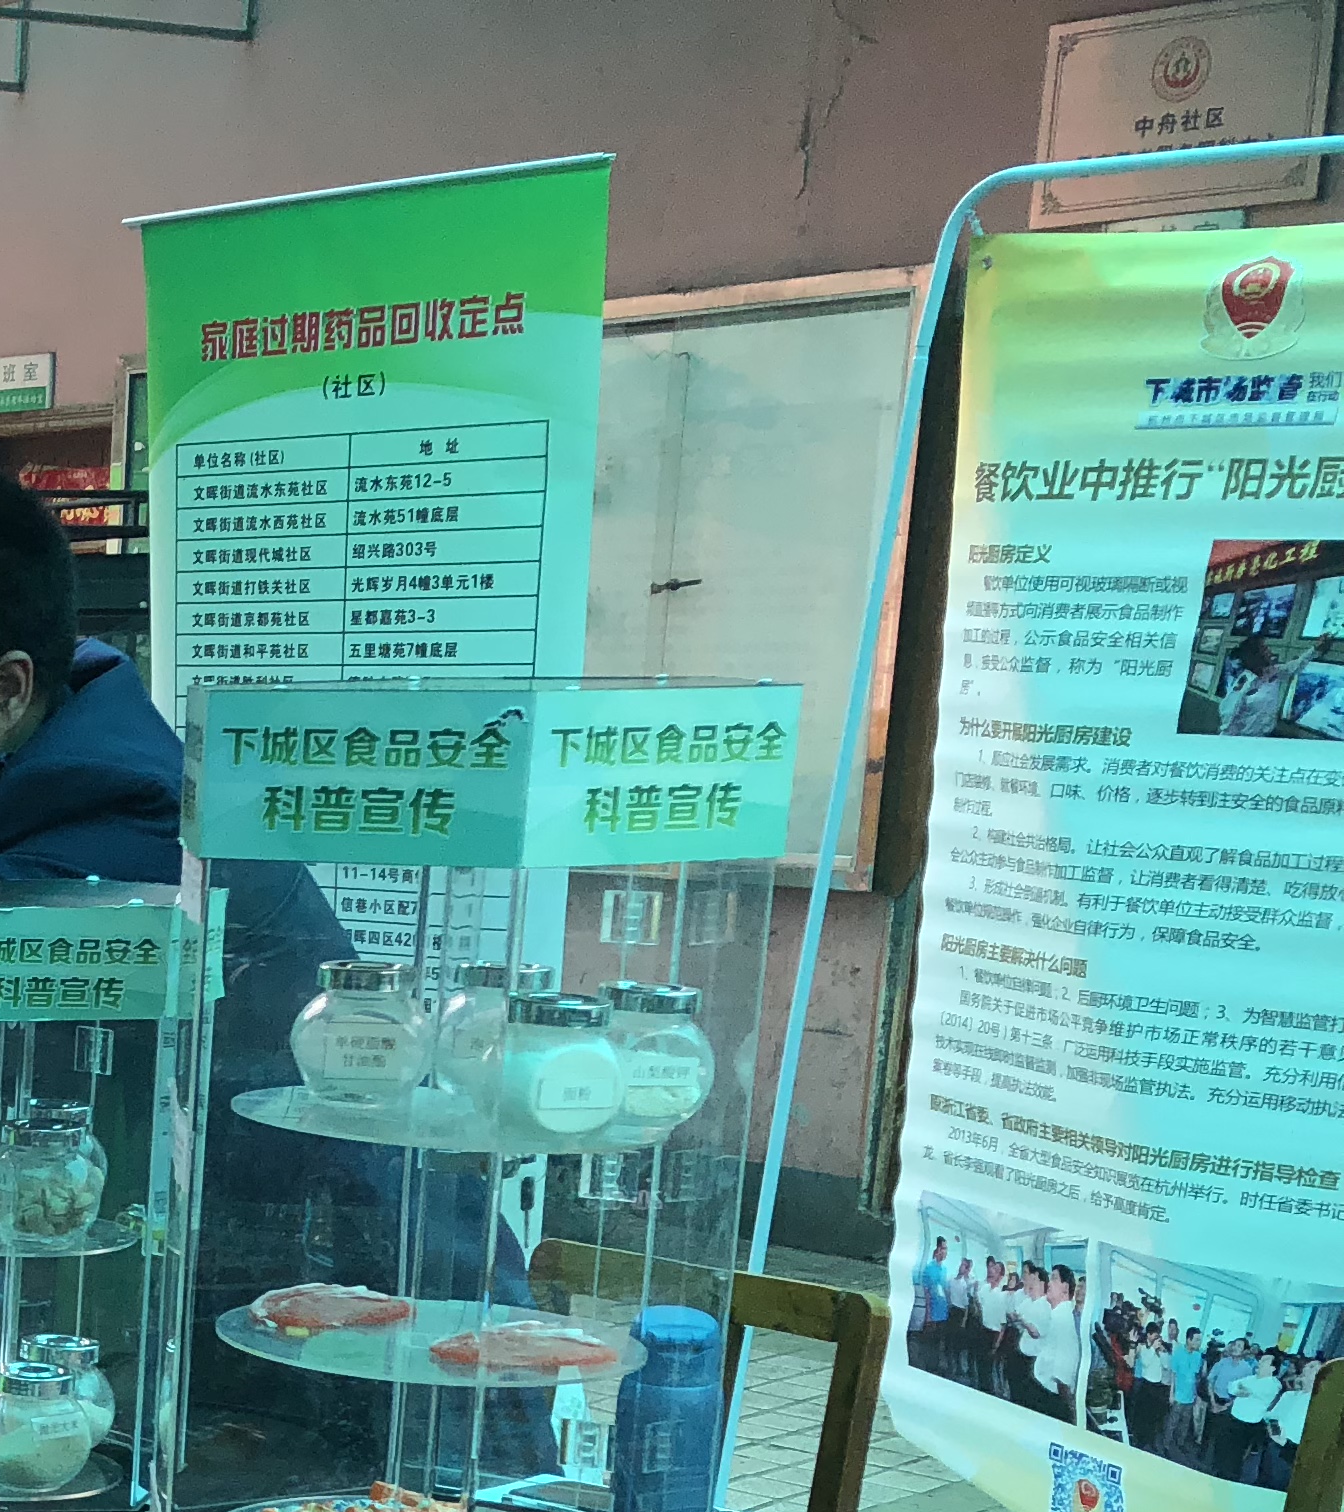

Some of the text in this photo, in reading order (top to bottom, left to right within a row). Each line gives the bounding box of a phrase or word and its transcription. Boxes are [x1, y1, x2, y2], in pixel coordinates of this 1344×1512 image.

[1134, 107, 1224, 138] 中舟社区
[200, 291, 527, 362] 家庭过期药品回收定点
[321, 374, 387, 400] (社区)
[193, 449, 285, 469] 单位名称(社区)
[193, 479, 328, 501] 文晖街道流水东苑社区
[354, 471, 452, 493] 流水东苑12-5
[193, 512, 326, 533] 文晖街道流水西苑社区
[352, 505, 459, 526] 流水苑51幢底层
[192, 546, 312, 565] 文晖街道现代城社区
[352, 540, 437, 560] 绍兴路303号
[192, 578, 311, 597] 文晖街道打铁关社区
[192, 611, 310, 629] 文晖街道京都苑社区
[192, 643, 309, 659] 文晖街道和平苑社区
[222, 726, 511, 771] 下城区食品安全
[550, 721, 788, 767] 下城区食品安全
[262, 785, 456, 836] 科普宣传
[585, 782, 742, 835] 科普宣传
[343, 866, 419, 884] 11-14号商
